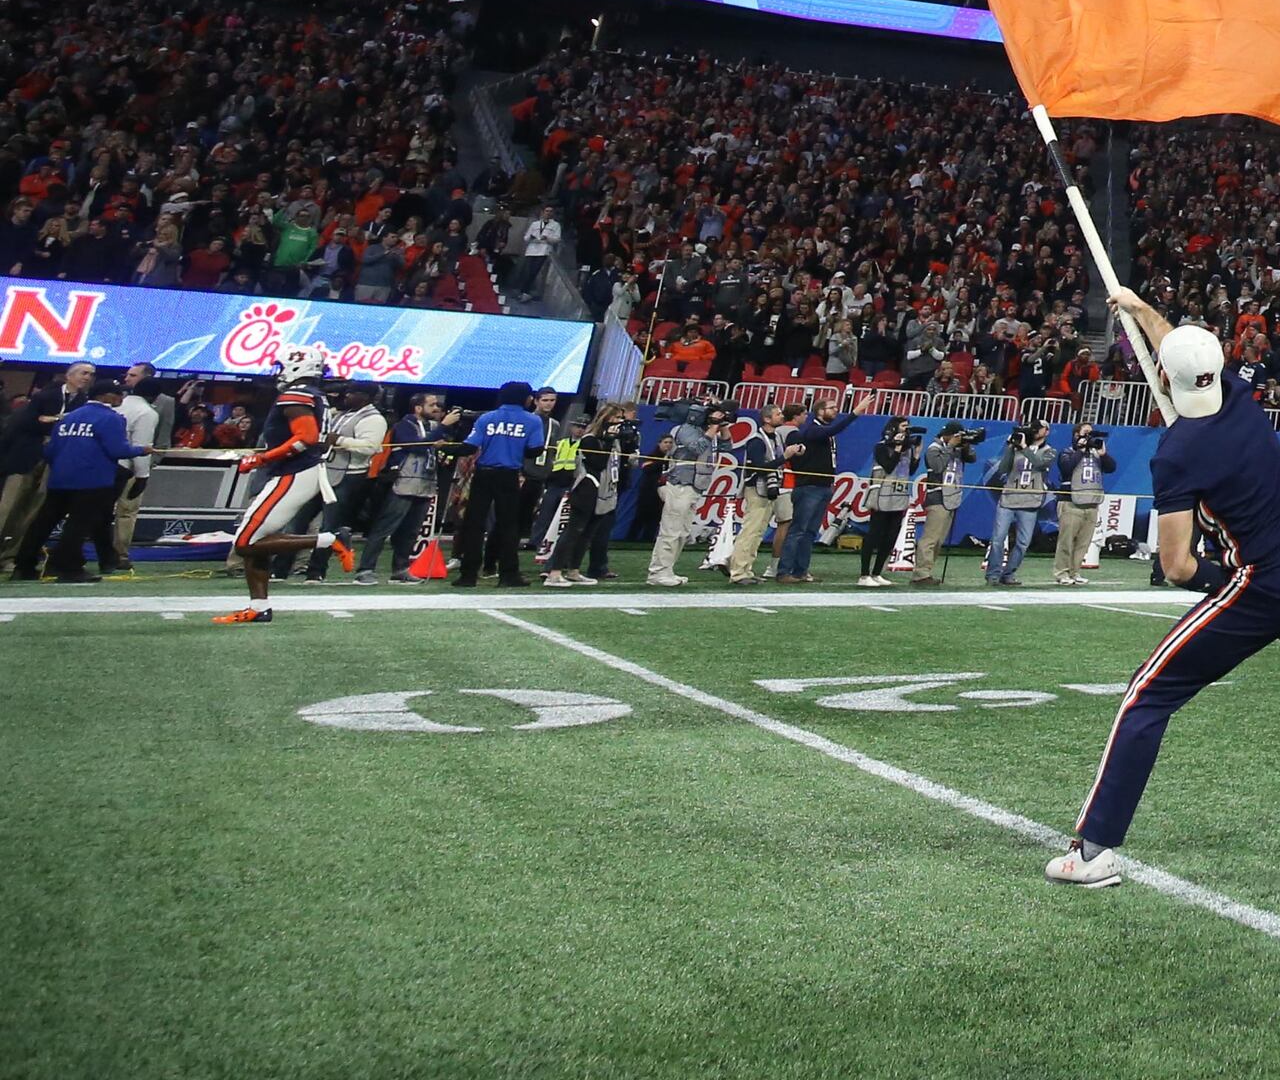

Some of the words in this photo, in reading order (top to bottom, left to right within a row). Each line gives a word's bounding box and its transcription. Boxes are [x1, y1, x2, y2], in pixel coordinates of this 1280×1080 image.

[224, 304, 421, 378] Ch-fil-A
[902, 511, 917, 565] AUBURN
[1106, 498, 1122, 532] TRACK
